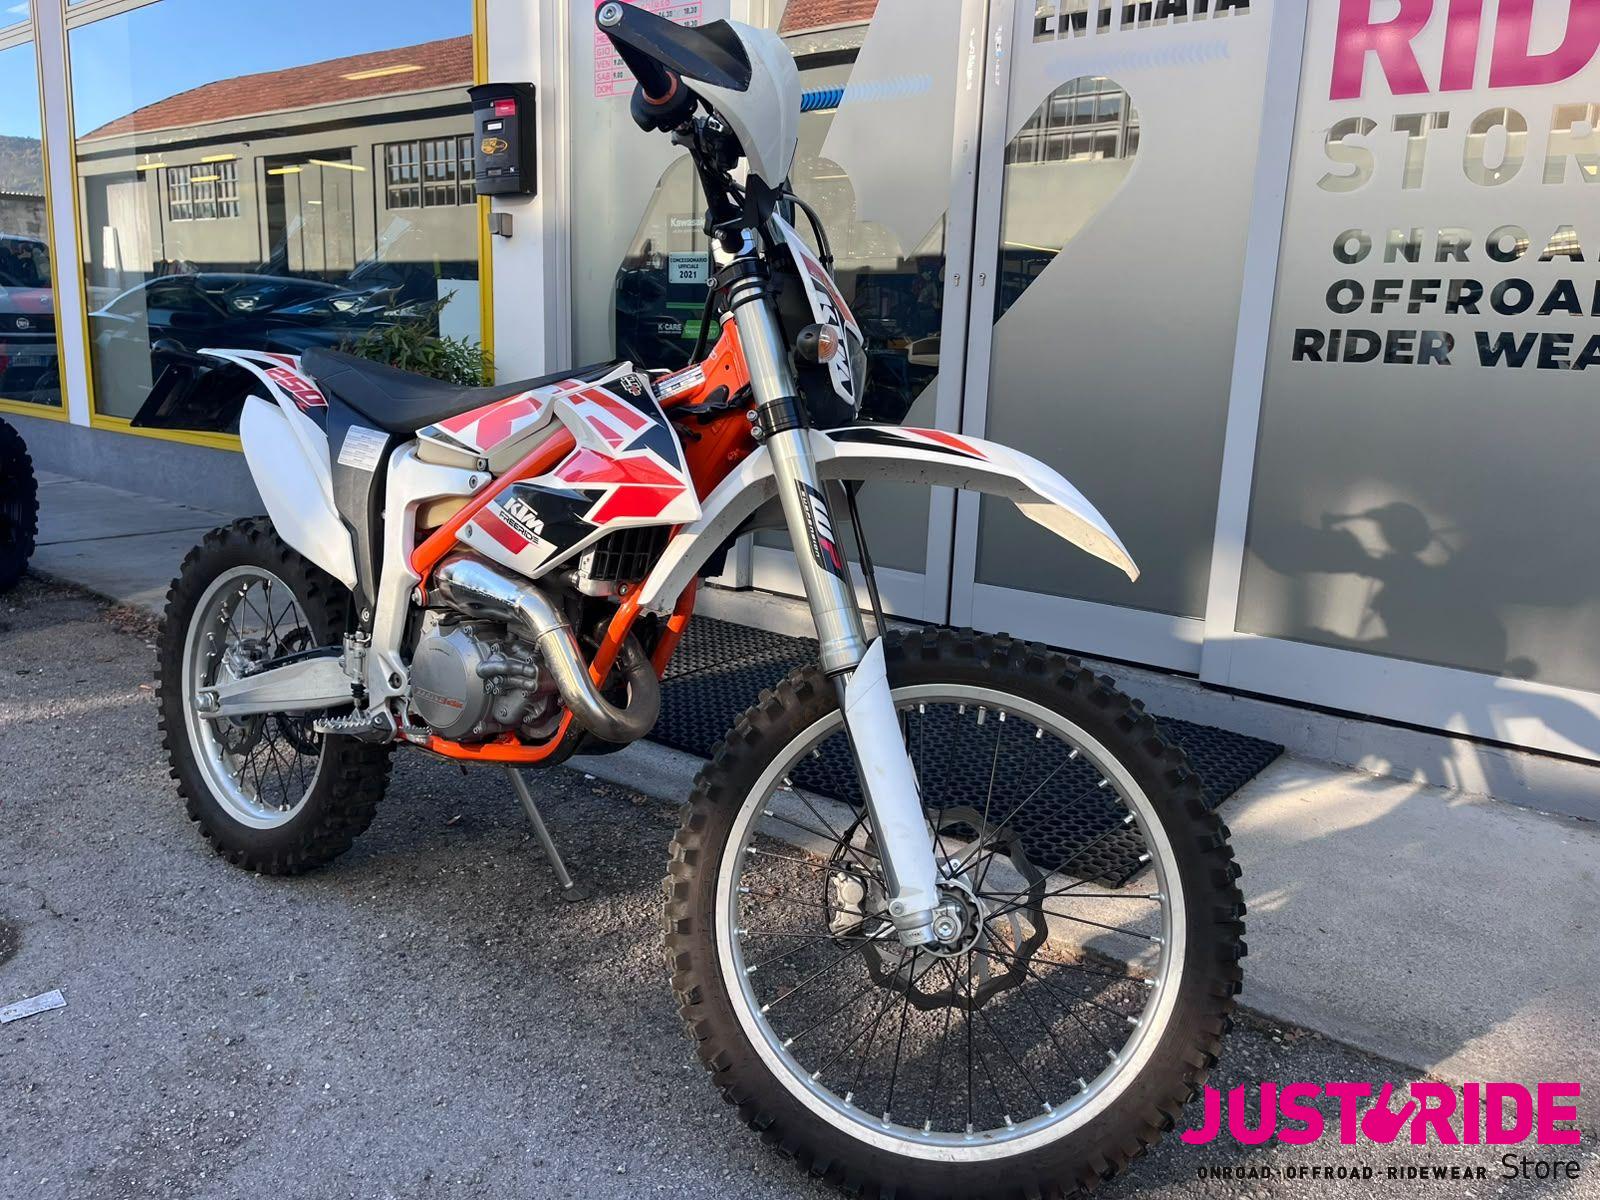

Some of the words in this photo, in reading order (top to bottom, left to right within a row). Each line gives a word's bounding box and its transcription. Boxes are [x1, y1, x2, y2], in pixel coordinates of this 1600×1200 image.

[597, 59, 611, 69] VEN
[597, 72, 611, 82] SAB
[1316, 103, 1600, 192] STOR
[1333, 225, 1600, 264] ONROA
[679, 271, 697, 279] 2021
[1326, 278, 1600, 316] OFFROA
[1292, 328, 1455, 365] RIDER
[264, 366, 329, 407] 250
[499, 510, 540, 545] FREERIDE
[503, 497, 545, 536] KTM
